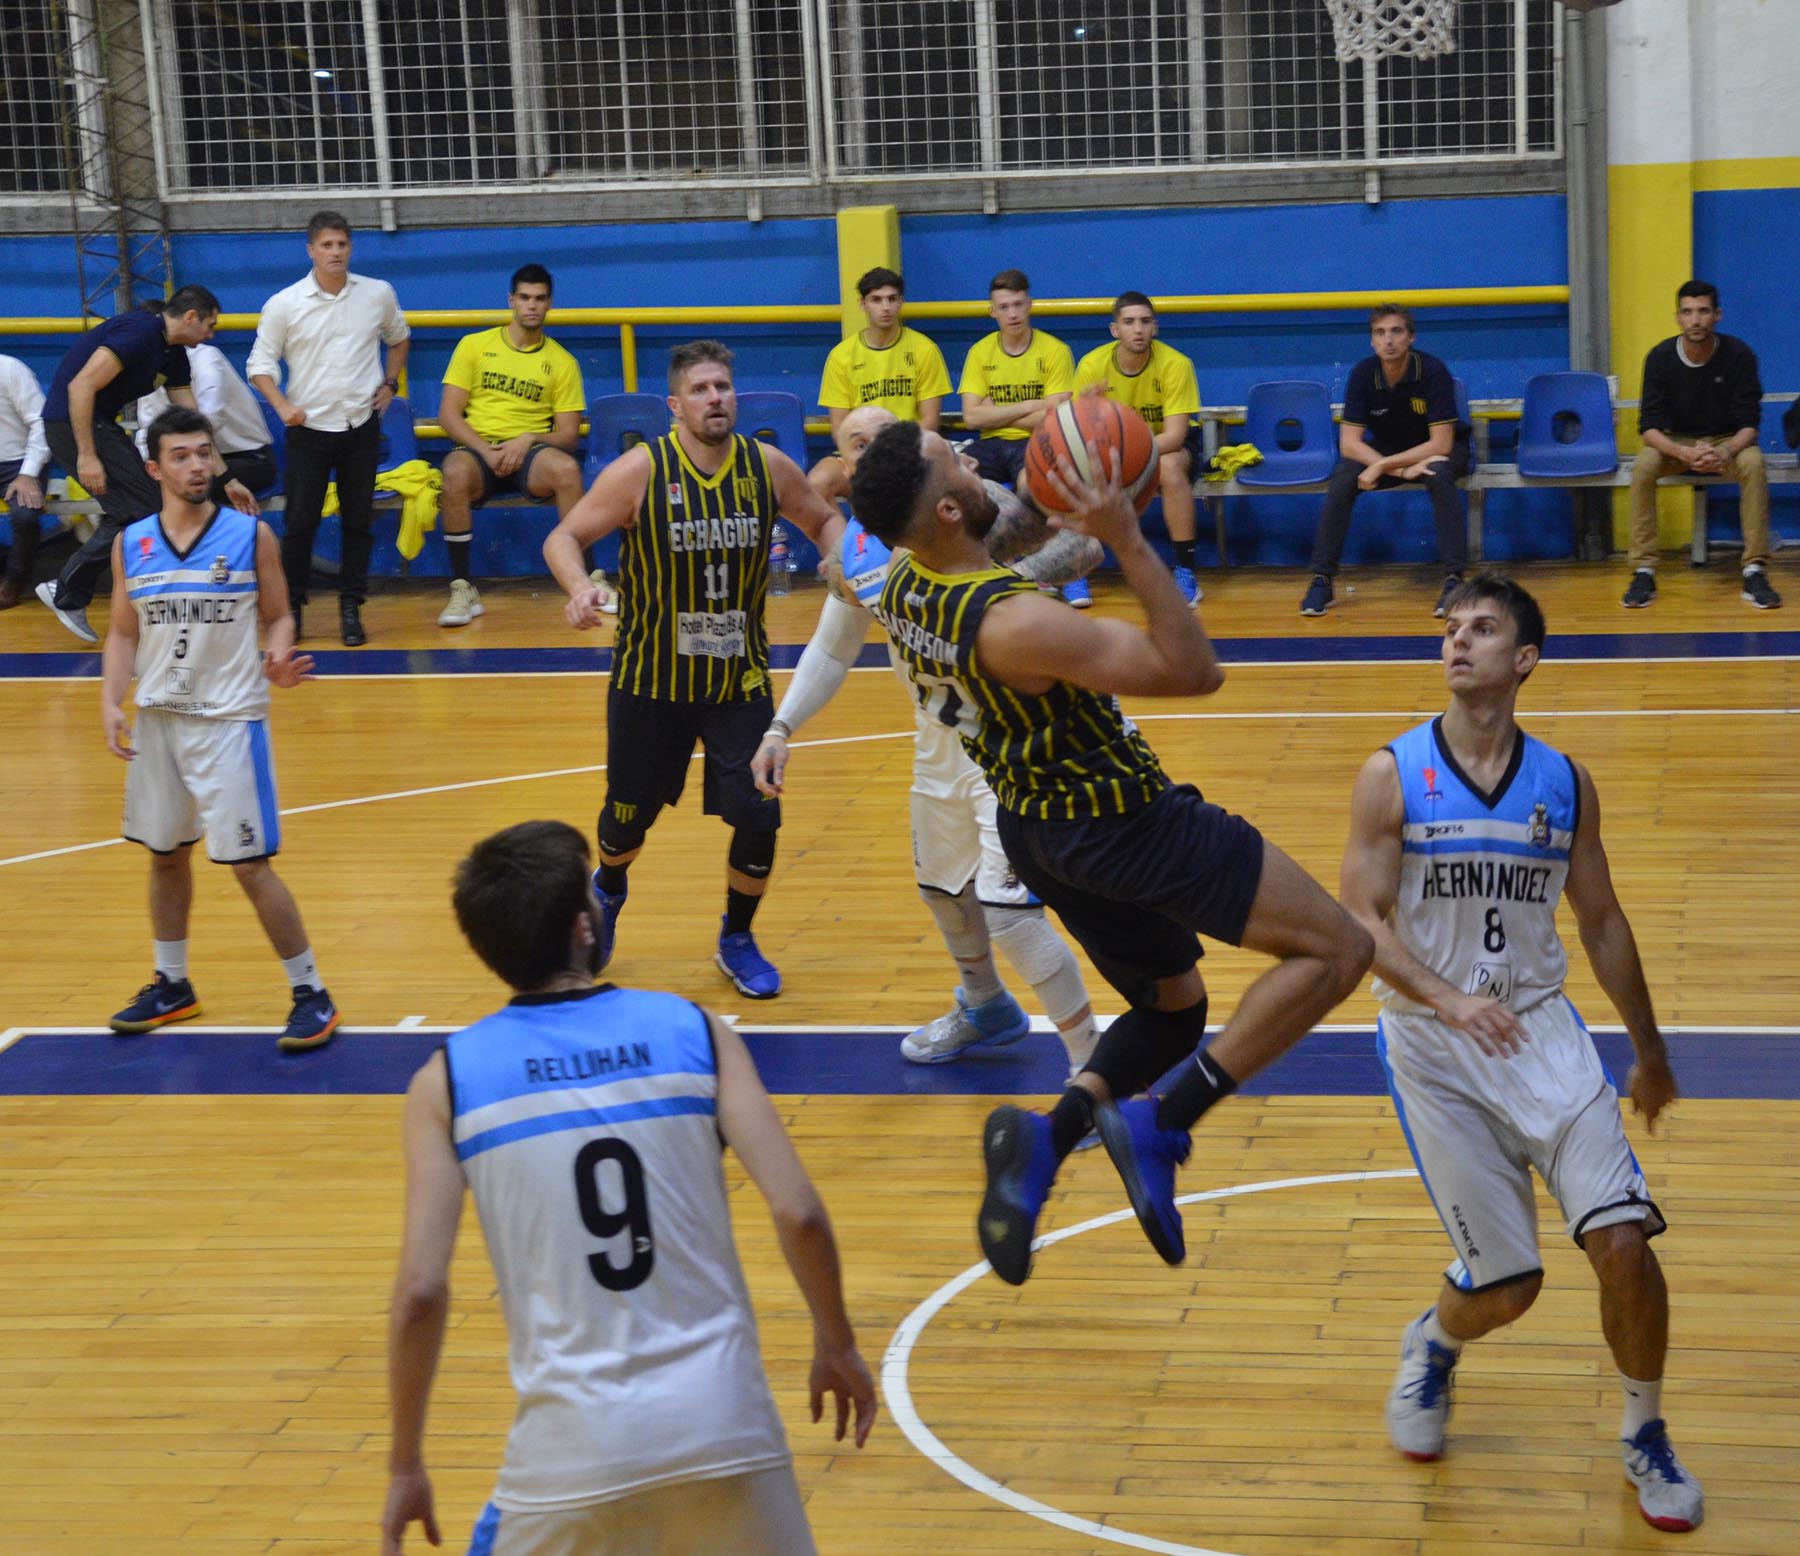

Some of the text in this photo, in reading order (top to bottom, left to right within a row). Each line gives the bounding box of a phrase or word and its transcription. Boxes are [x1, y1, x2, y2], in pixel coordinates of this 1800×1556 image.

[669, 512, 760, 552] ECHAGÜE
[703, 563, 730, 600] 11
[173, 629, 189, 660] 5
[1483, 907, 1506, 953] 8
[574, 1137, 656, 1292] 9
